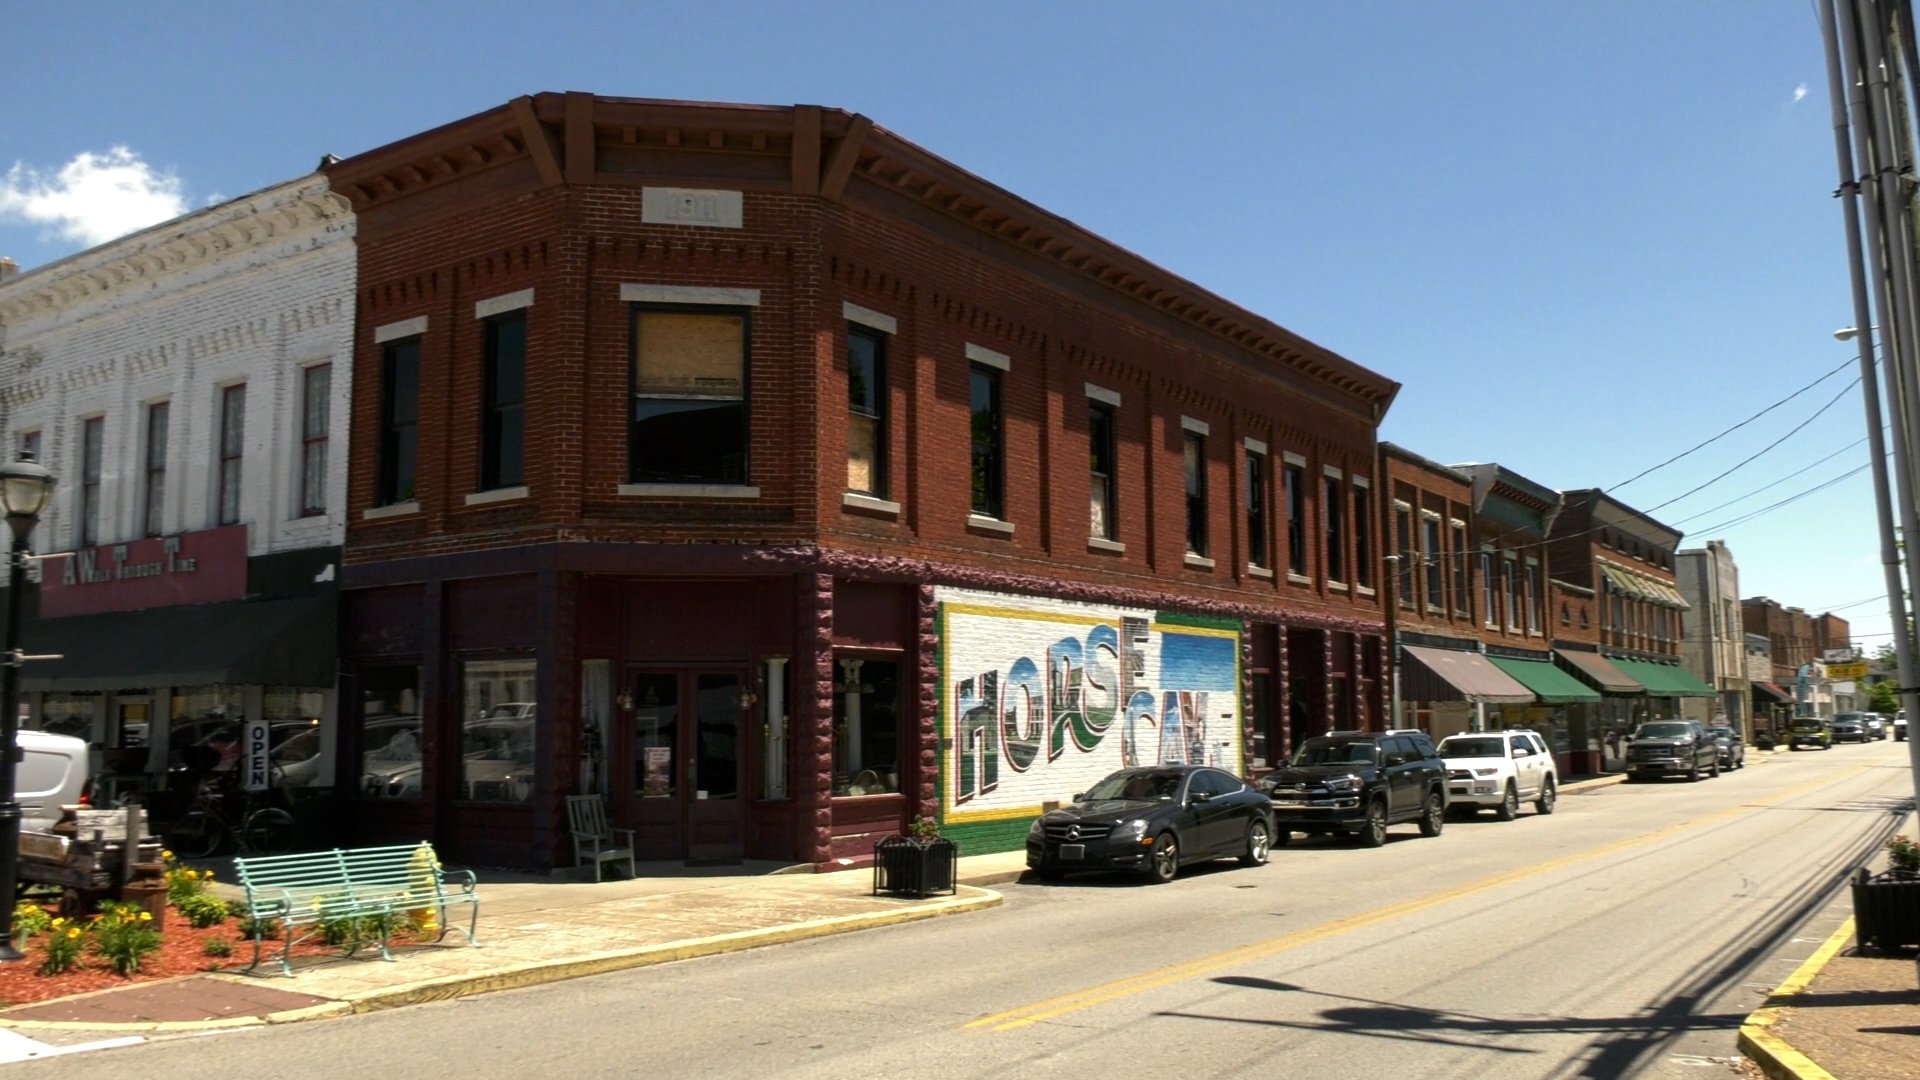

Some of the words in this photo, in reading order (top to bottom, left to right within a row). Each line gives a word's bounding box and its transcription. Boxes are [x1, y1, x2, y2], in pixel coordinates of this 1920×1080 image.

[665, 193, 718, 221] 1911
[955, 616, 1150, 806] HORSE
[252, 726, 265, 785] OPEN
